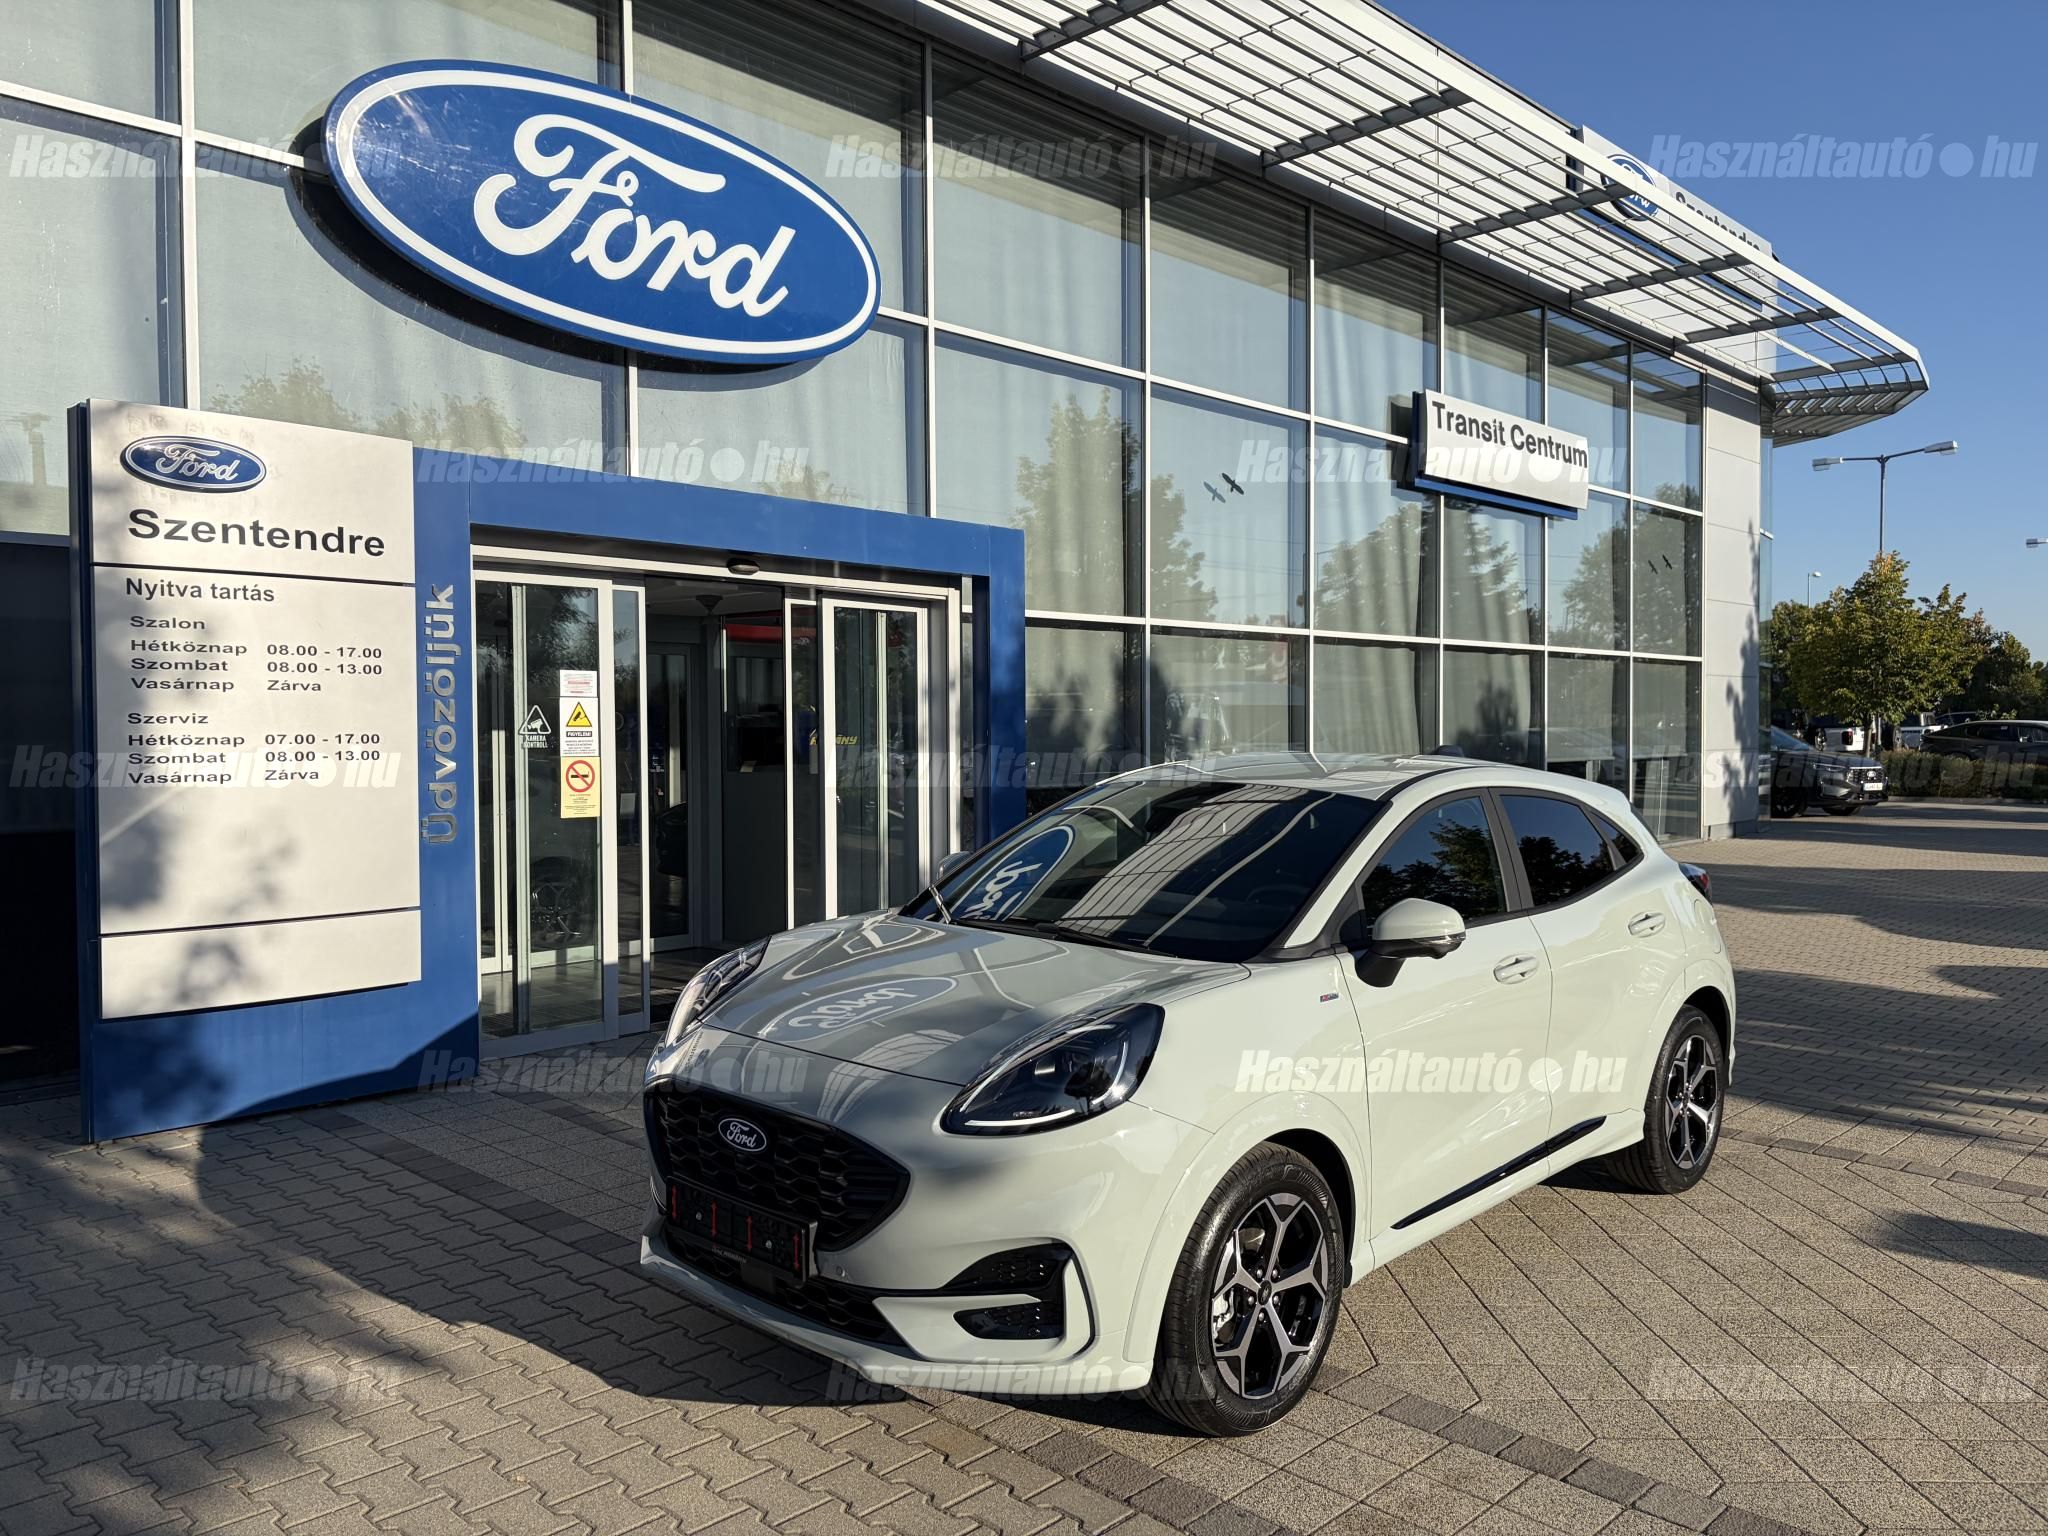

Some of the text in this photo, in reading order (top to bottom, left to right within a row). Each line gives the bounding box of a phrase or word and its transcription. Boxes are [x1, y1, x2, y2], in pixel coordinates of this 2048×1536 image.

[474, 113, 796, 317] Ford
[1432, 401, 1588, 469] Transit Centrum
[155, 444, 241, 481] Ford
[128, 509, 385, 557] Szentendre
[126, 577, 275, 602] Nyitva tartás
[130, 616, 206, 630] Szalon
[131, 640, 247, 656] Hétköznap
[267, 644, 317, 656] 08.00
[336, 646, 382, 658] 17.00
[131, 658, 228, 671] Szombat
[267, 661, 318, 673] 08.00
[336, 663, 382, 675] 13.00
[131, 678, 321, 692] Vasárnap Zárva
[128, 713, 209, 725] Szerviz
[421, 584, 461, 843] Üdvözöljük
[128, 733, 245, 747] Hétköznap
[265, 734, 315, 745] 07.00
[335, 733, 380, 744] 17.00
[128, 752, 226, 764] Szombat
[265, 750, 315, 762] 08.00
[335, 750, 380, 761] 13.00
[128, 768, 319, 784] Vasárnap Zárva
[726, 1121, 757, 1148] Ford
